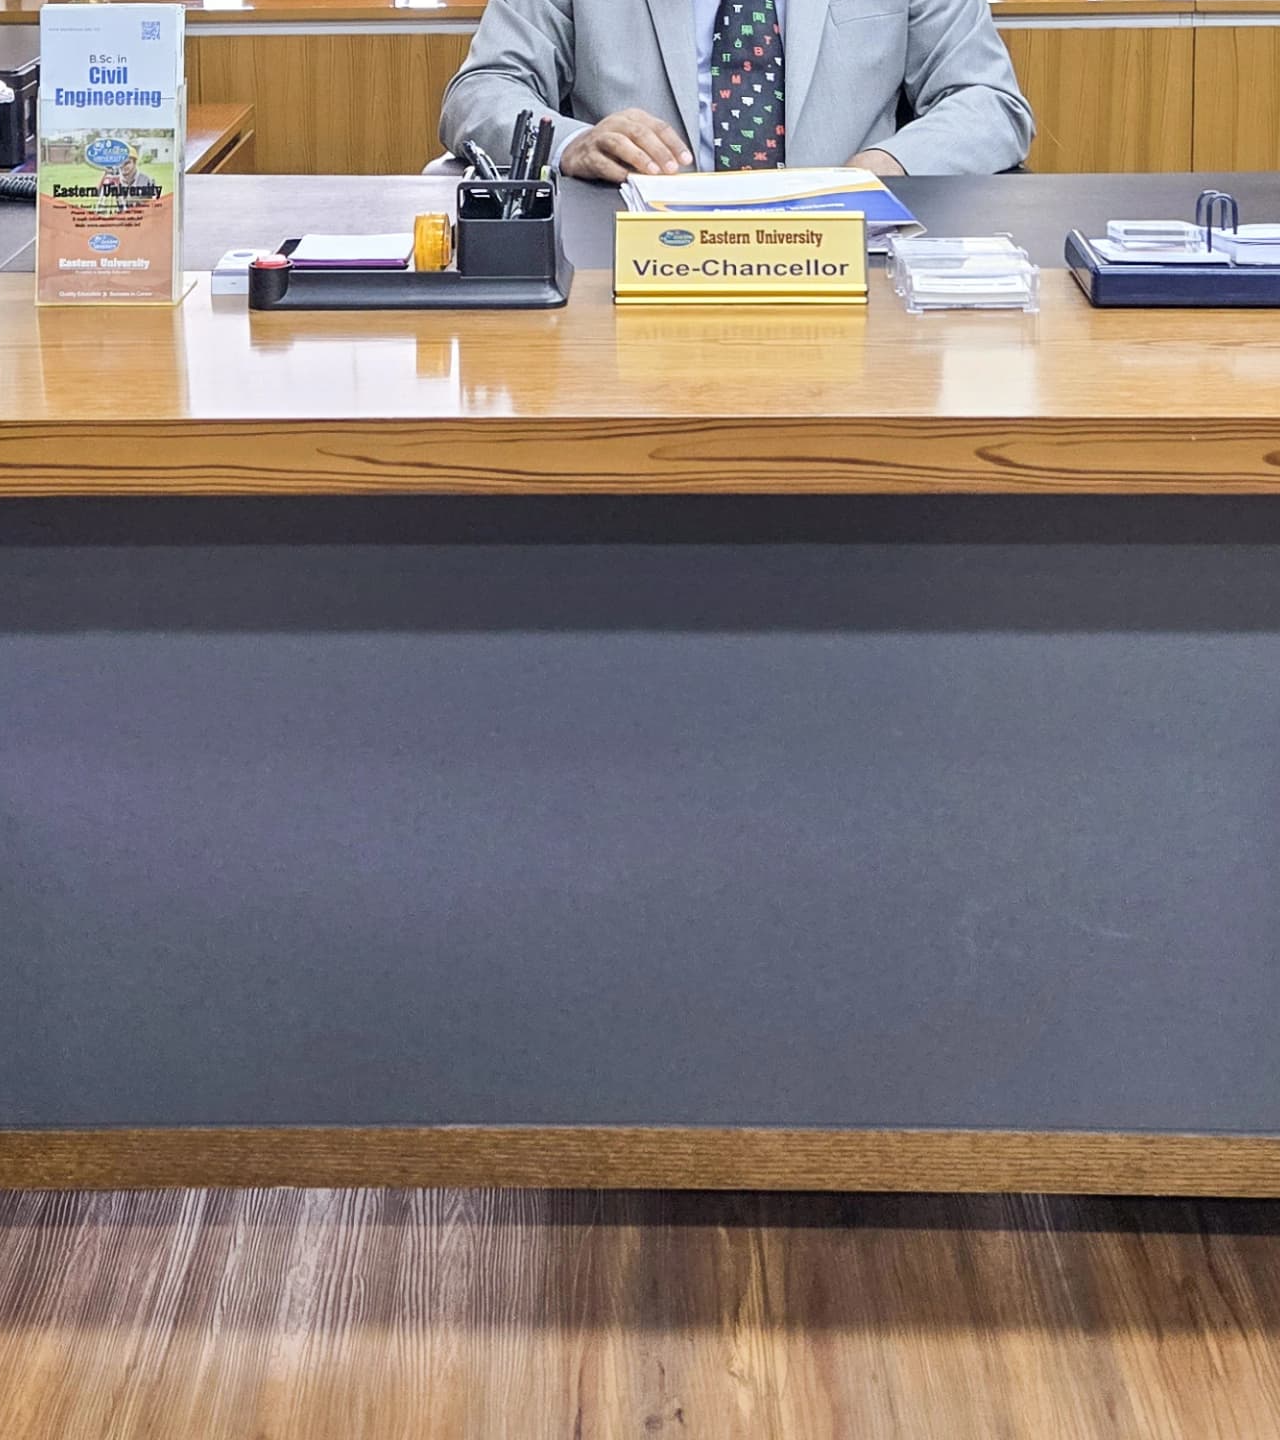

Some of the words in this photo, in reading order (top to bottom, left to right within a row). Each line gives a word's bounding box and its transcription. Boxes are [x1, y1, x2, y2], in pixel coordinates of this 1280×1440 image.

[89, 54, 115, 64] B.Sc.
[117, 54, 128, 64] in
[89, 66, 128, 85] Civil
[55, 88, 162, 108] Engineering
[53, 184, 100, 198] Eastern
[103, 182, 163, 200] University
[700, 229, 751, 245] Eastern
[756, 229, 824, 248] University
[59, 258, 98, 269] Eastern
[100, 257, 151, 270] University
[632, 259, 850, 277] Vice-Chancellor
